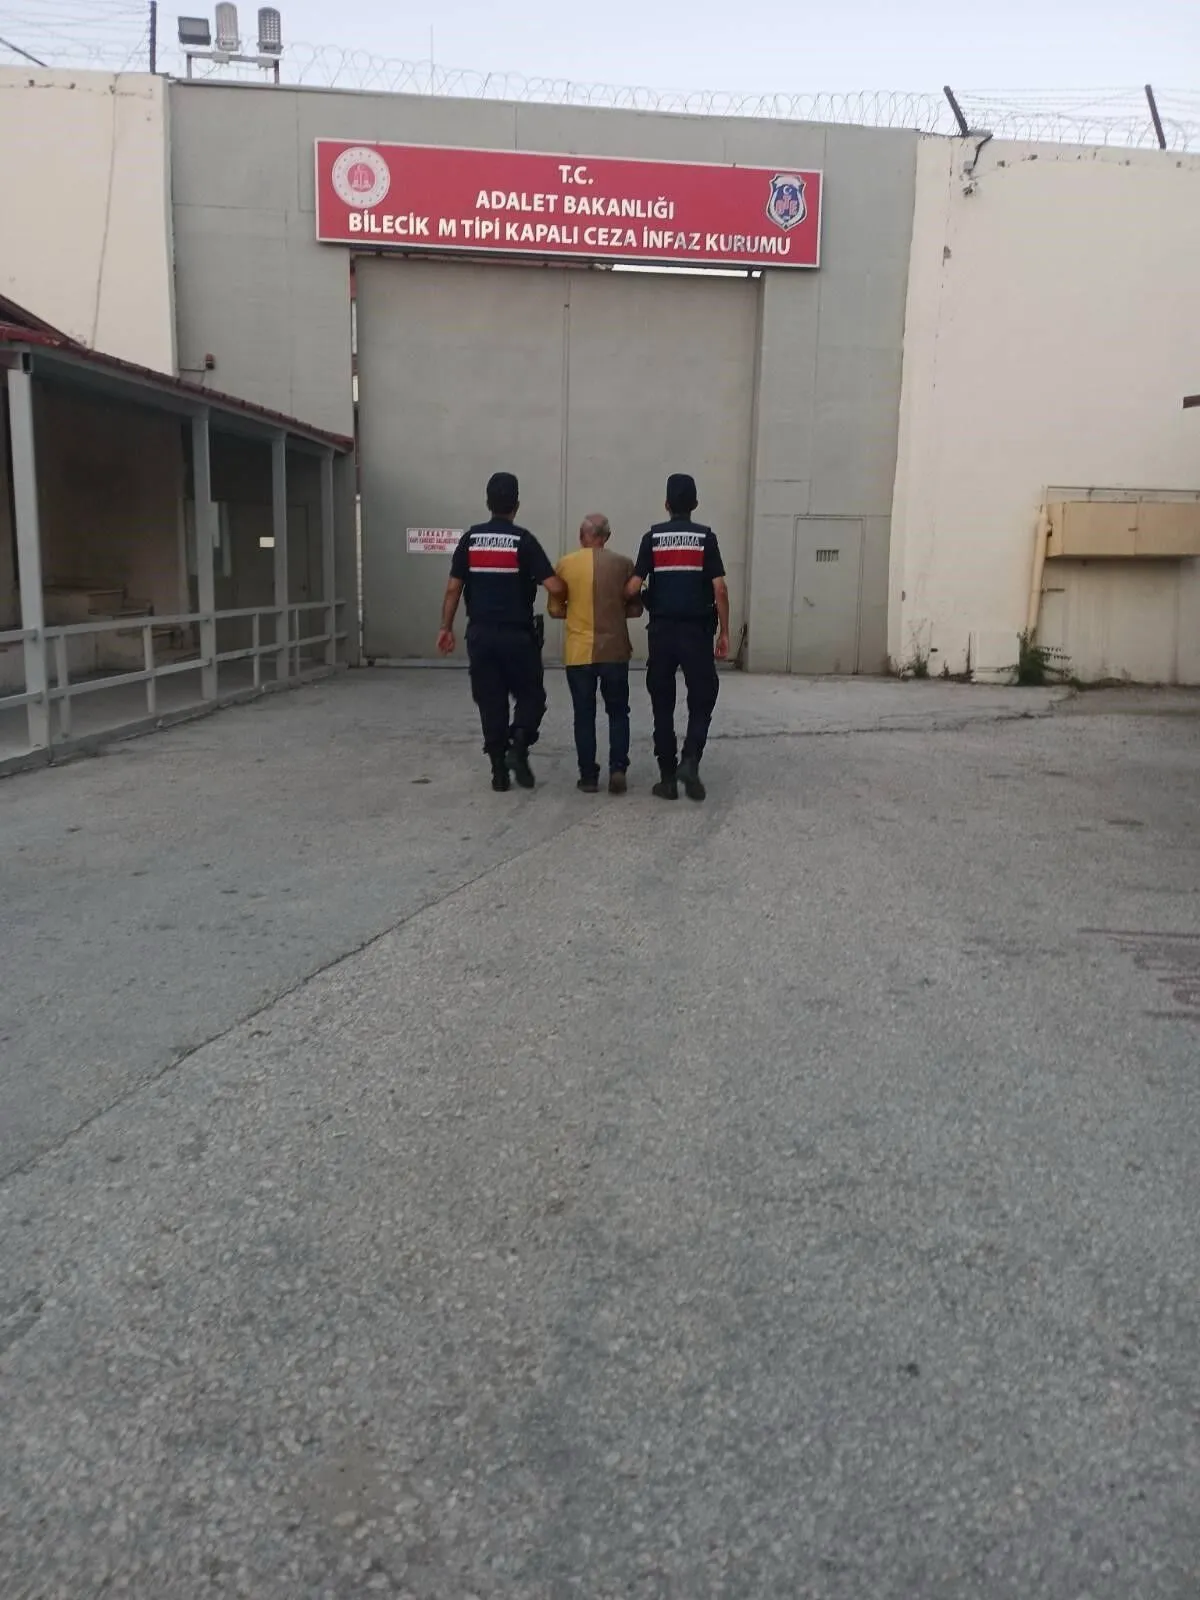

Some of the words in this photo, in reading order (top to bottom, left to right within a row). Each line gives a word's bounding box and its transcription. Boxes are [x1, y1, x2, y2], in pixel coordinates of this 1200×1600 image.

[559, 165, 593, 185] T.C.
[476, 191, 558, 213] ADALET
[564, 195, 674, 219] BAKANLIĞI
[349, 210, 429, 236] BİLECİK
[438, 220, 456, 237] M
[461, 216, 500, 240] TİPİ
[506, 223, 578, 244] KAPALI
[584, 226, 636, 247] CEZA
[643, 225, 700, 251] İNFAZ
[705, 233, 790, 254] KURUMU
